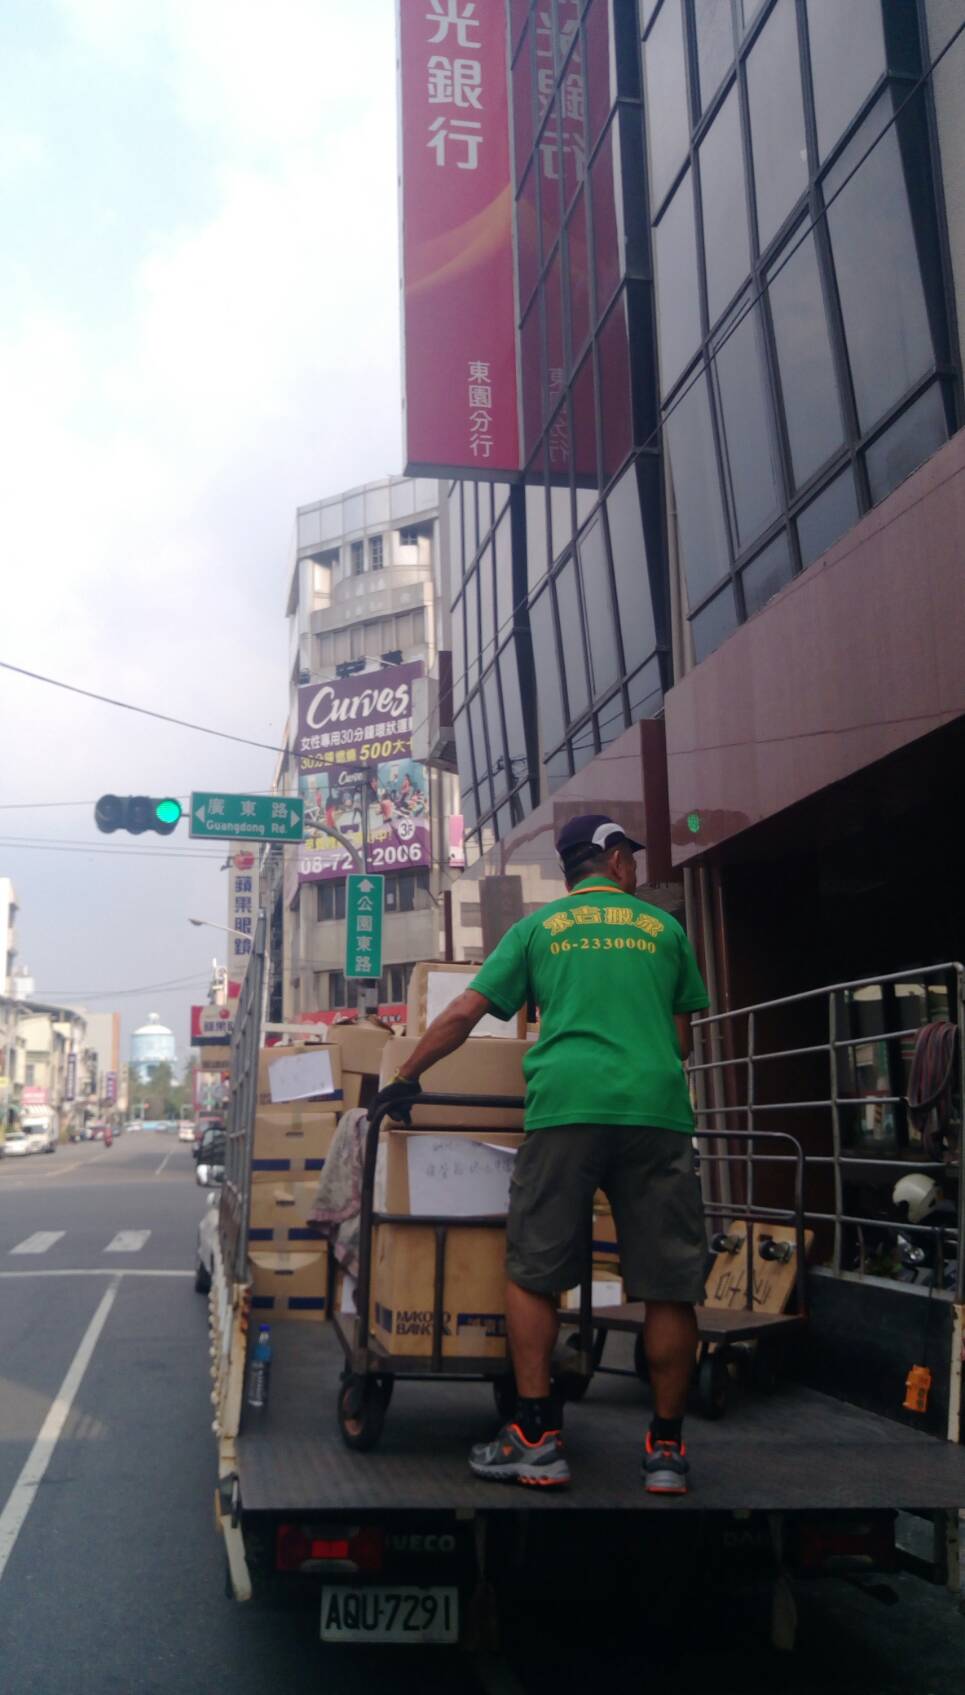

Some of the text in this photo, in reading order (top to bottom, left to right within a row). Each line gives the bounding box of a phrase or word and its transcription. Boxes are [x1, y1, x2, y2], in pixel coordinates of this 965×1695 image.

[425, 0, 484, 170] 光銀行
[468, 361, 494, 458] 東園分行
[306, 684, 409, 729] Curves
[206, 820, 265, 835] Guangdong
[207, 798, 288, 819] 廣東路
[355, 895, 374, 973] 公園東路
[550, 937, 657, 955] 06-2330000
[396, 1310, 452, 1323] MAKOO
[324, 1592, 451, 1632] AQU-7291
